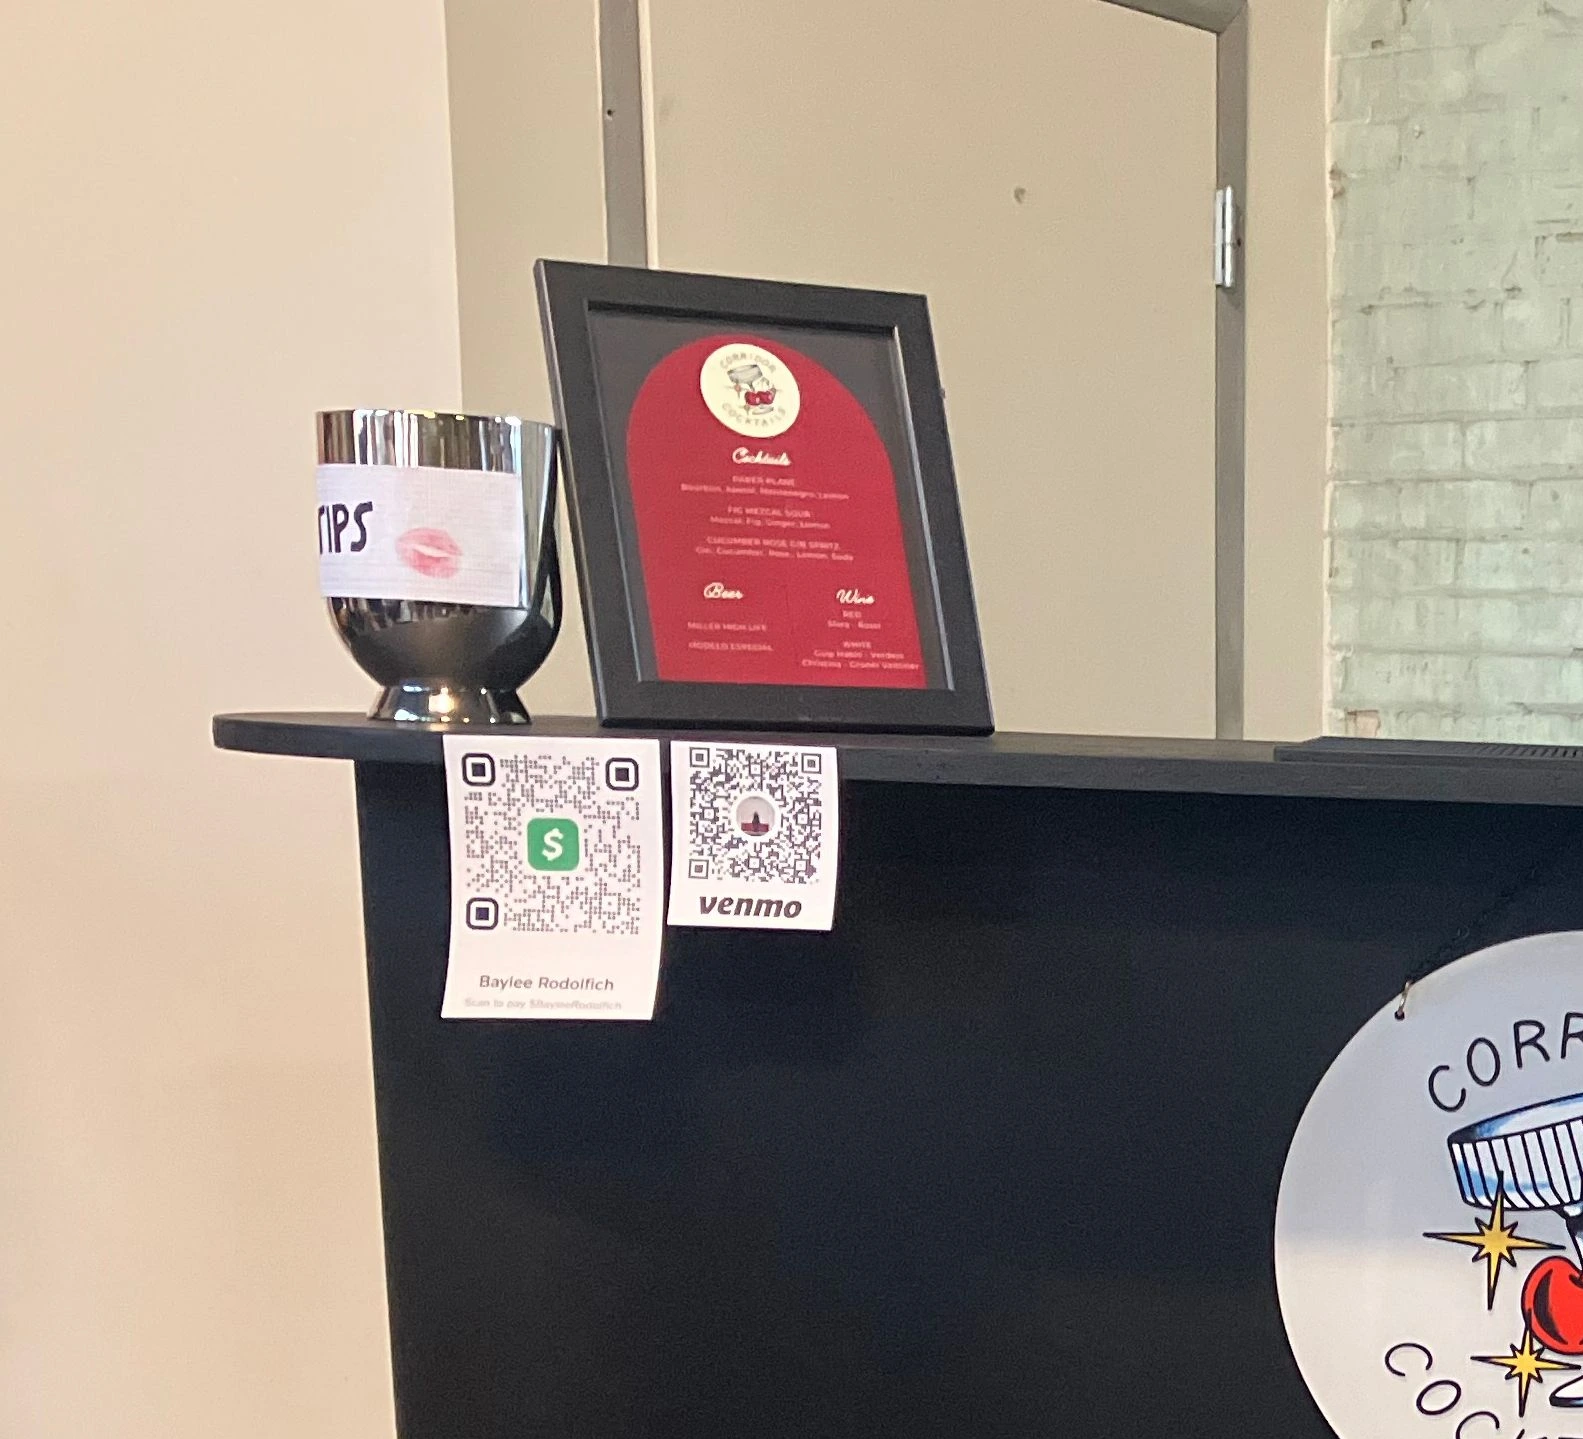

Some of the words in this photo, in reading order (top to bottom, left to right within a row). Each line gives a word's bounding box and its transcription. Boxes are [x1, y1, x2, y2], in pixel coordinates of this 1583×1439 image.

[732, 446, 792, 467] Cocktails
[703, 582, 744, 600] Beer
[835, 589, 876, 605] Wine
[699, 895, 802, 919] venmo
[479, 975, 533, 992] Baylee
[538, 976, 615, 991] Rodolfich
